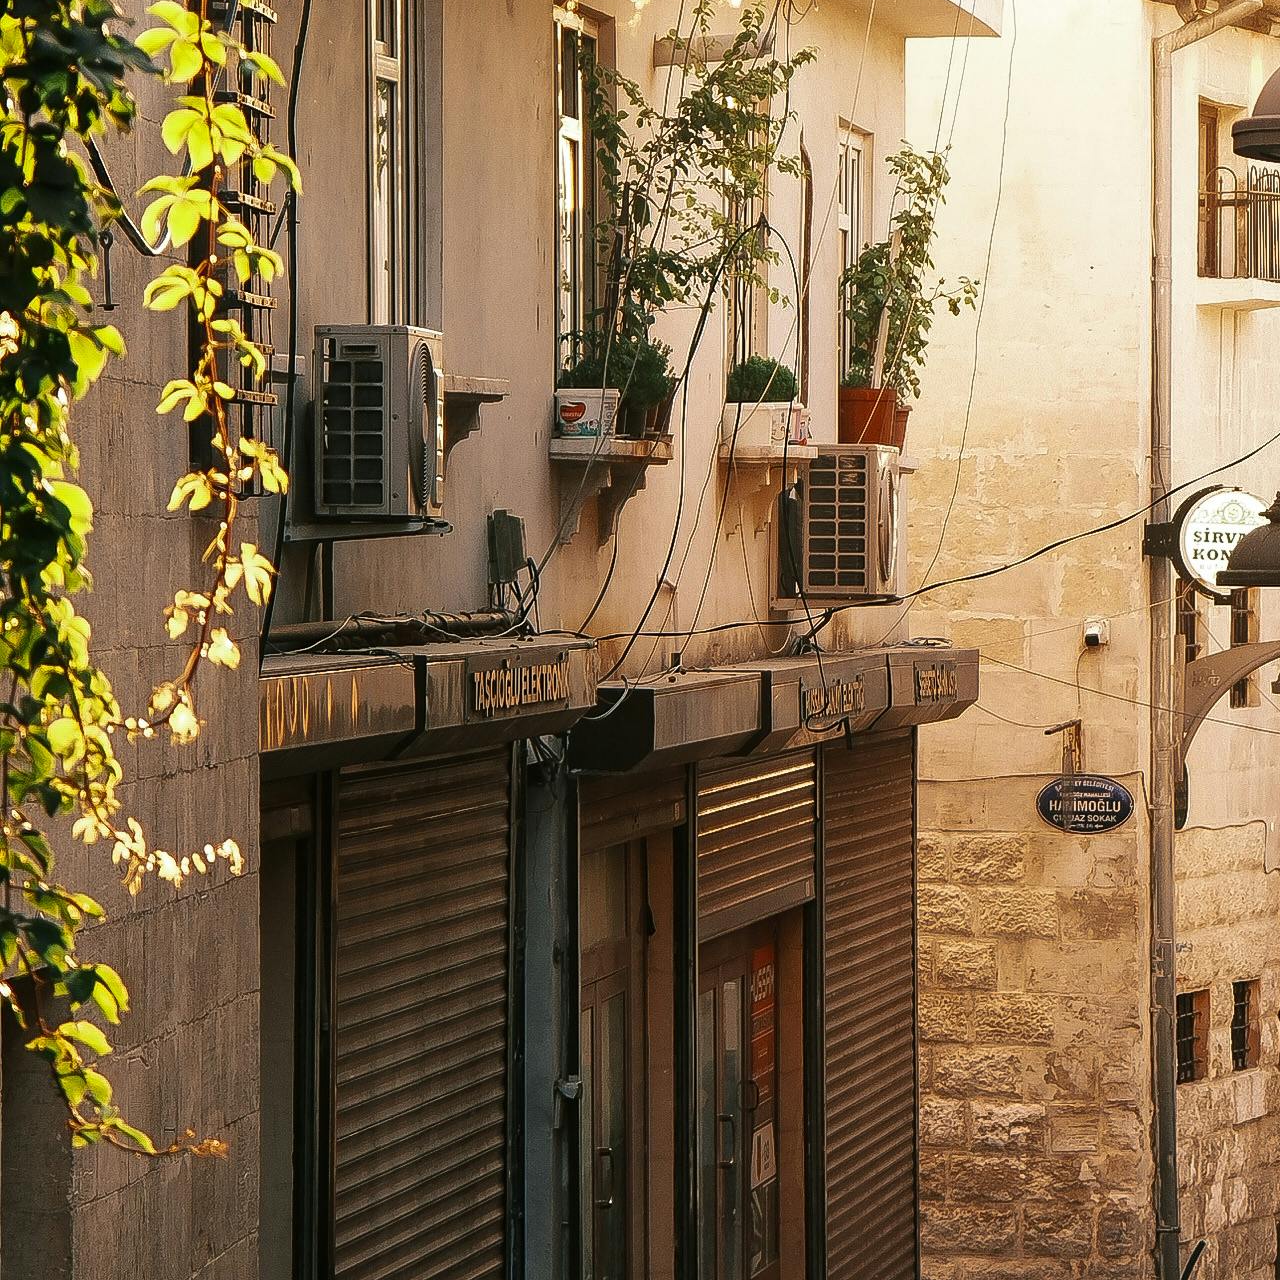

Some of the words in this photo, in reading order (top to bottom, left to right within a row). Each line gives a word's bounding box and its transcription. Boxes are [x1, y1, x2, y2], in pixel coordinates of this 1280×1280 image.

[1192, 548, 1233, 561] KON
[1049, 798, 1121, 812] HAİMOĞLU
[1087, 814, 1117, 822] SOKAK
